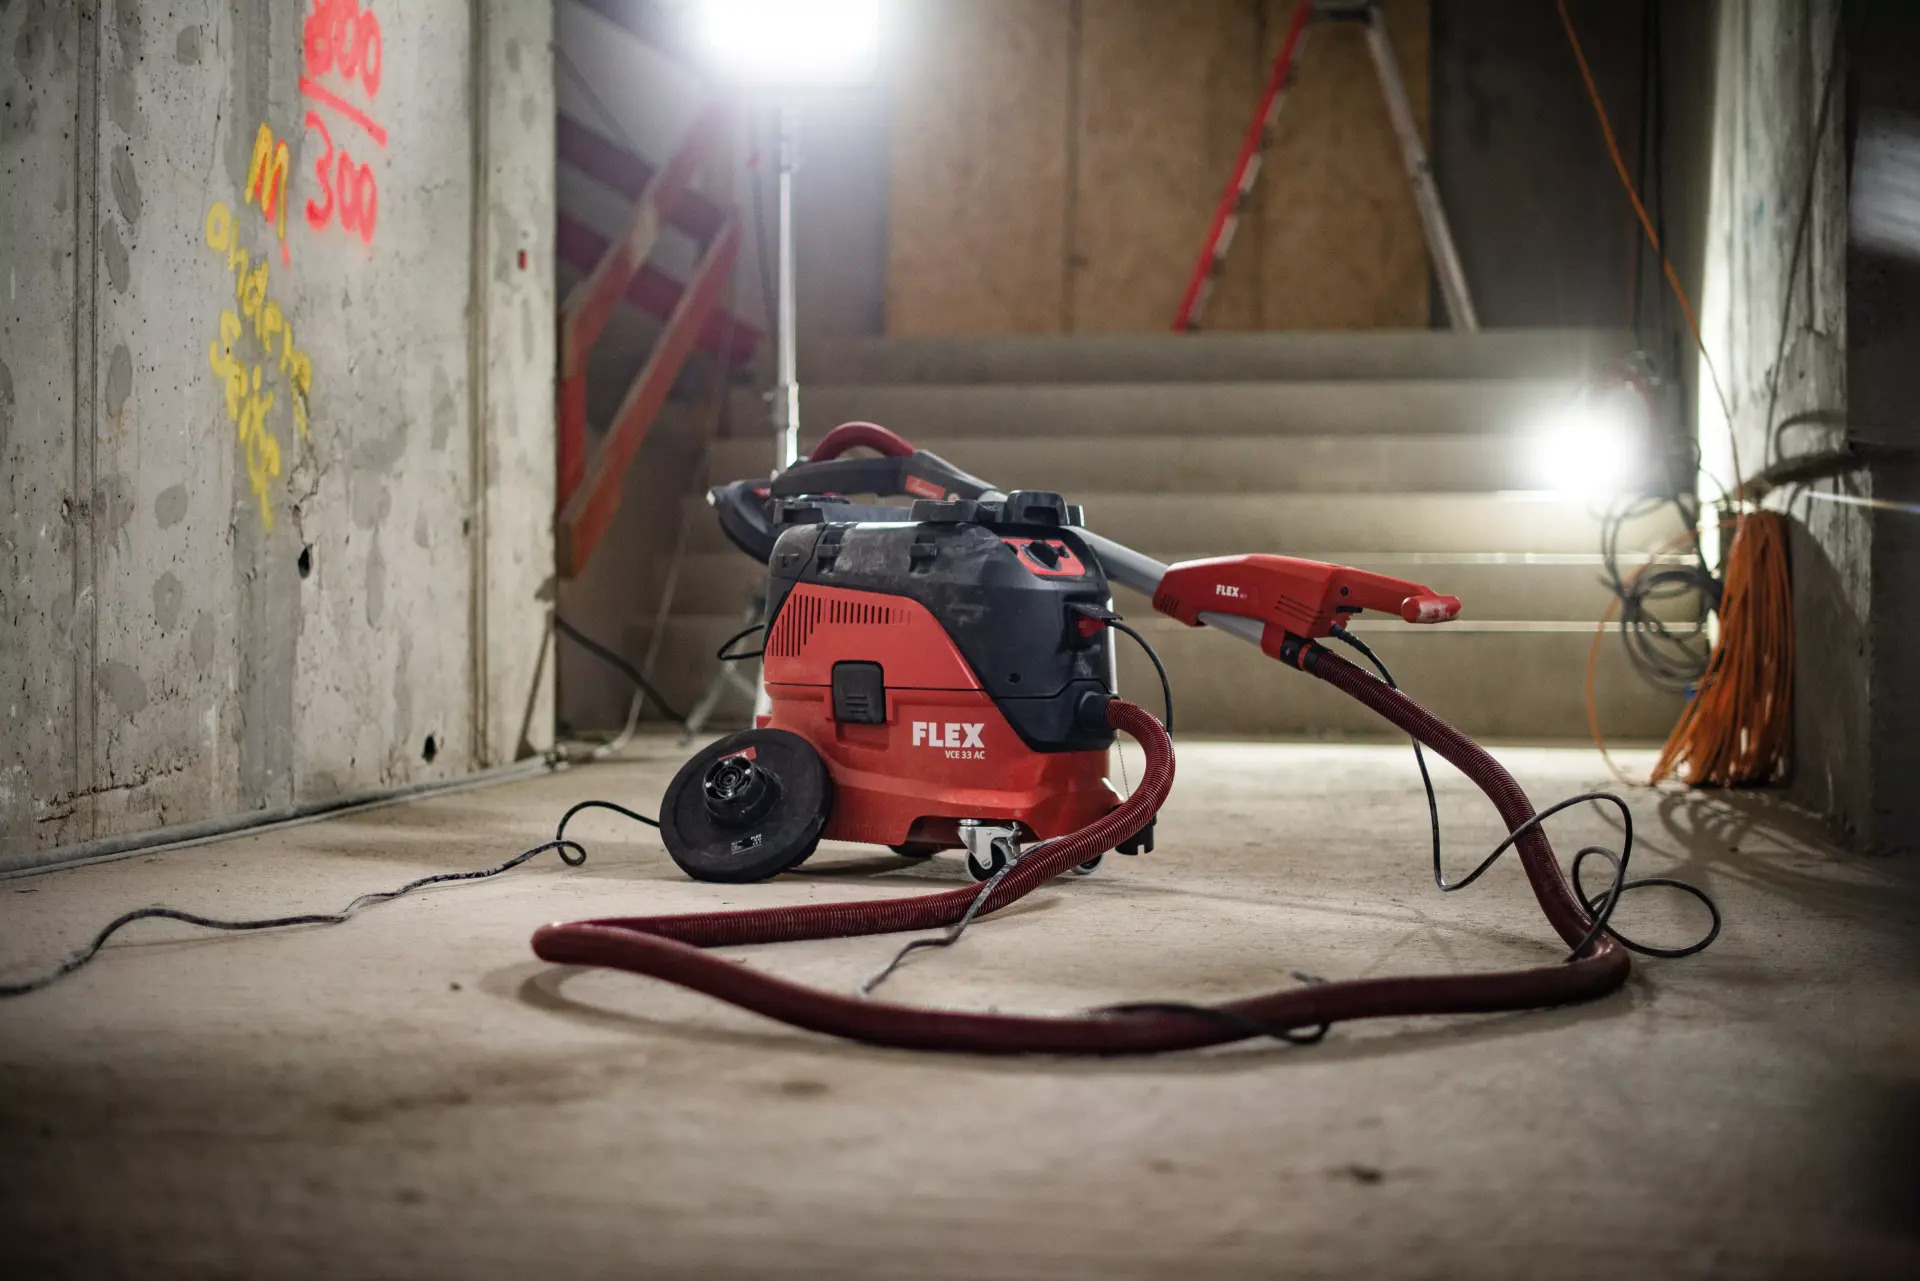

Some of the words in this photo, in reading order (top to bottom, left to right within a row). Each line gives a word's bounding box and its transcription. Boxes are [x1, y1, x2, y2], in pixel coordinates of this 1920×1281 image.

[304, 110, 378, 246] 300
[1215, 584, 1239, 598] FLEX
[912, 721, 985, 748] FLEX
[945, 750, 960, 759] VCE
[962, 751, 972, 759] 33
[974, 751, 985, 760] AC
